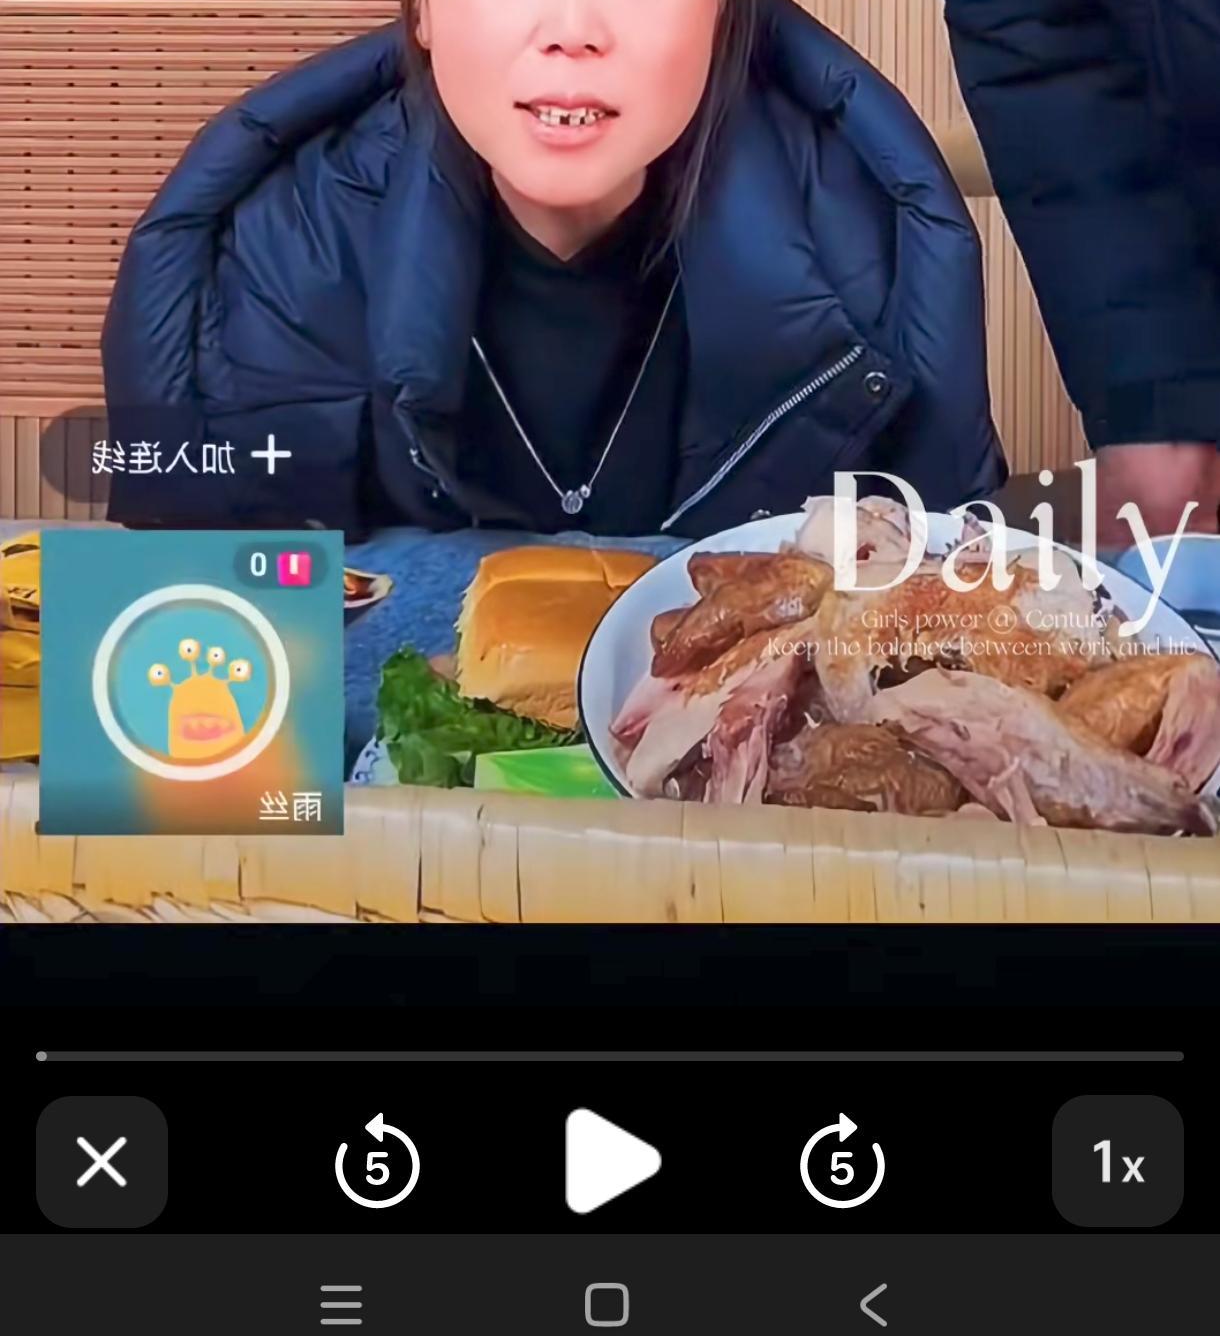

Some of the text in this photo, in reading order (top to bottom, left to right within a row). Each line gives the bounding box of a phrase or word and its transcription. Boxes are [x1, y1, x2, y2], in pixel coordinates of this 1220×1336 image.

[366, 1152, 390, 1186] 5
[831, 1152, 855, 1186] 5
[1093, 1140, 1145, 1183] 1x
